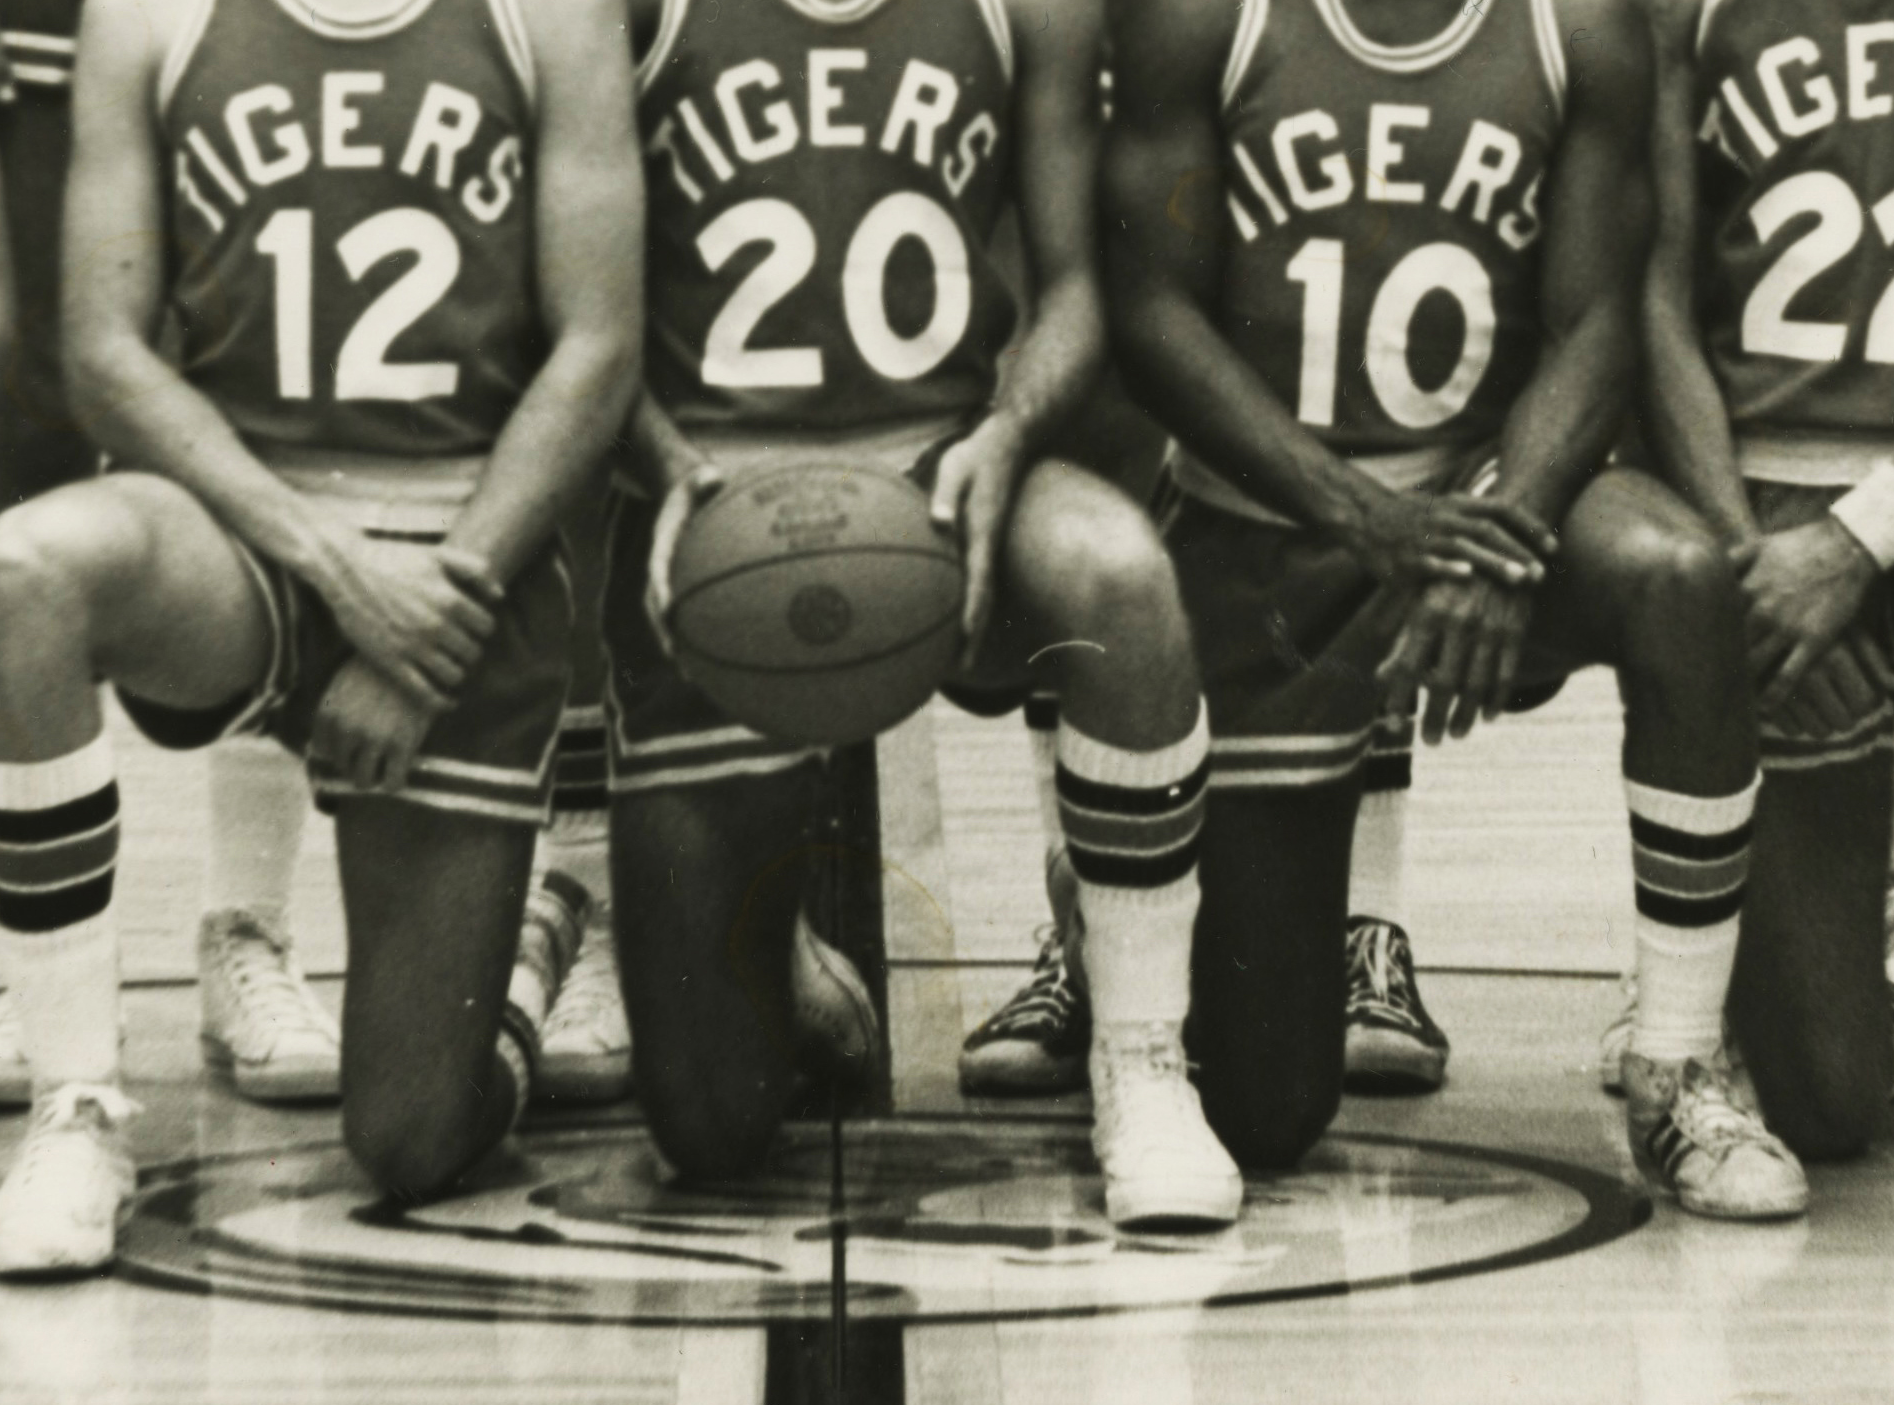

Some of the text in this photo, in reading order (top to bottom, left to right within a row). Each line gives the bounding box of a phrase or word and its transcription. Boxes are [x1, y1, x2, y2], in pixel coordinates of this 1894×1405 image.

[176, 71, 522, 232] TIGERS
[650, 48, 998, 202] TIGERS
[254, 206, 461, 401] 12
[695, 192, 971, 388] 20
[1286, 238, 1496, 429] 10
